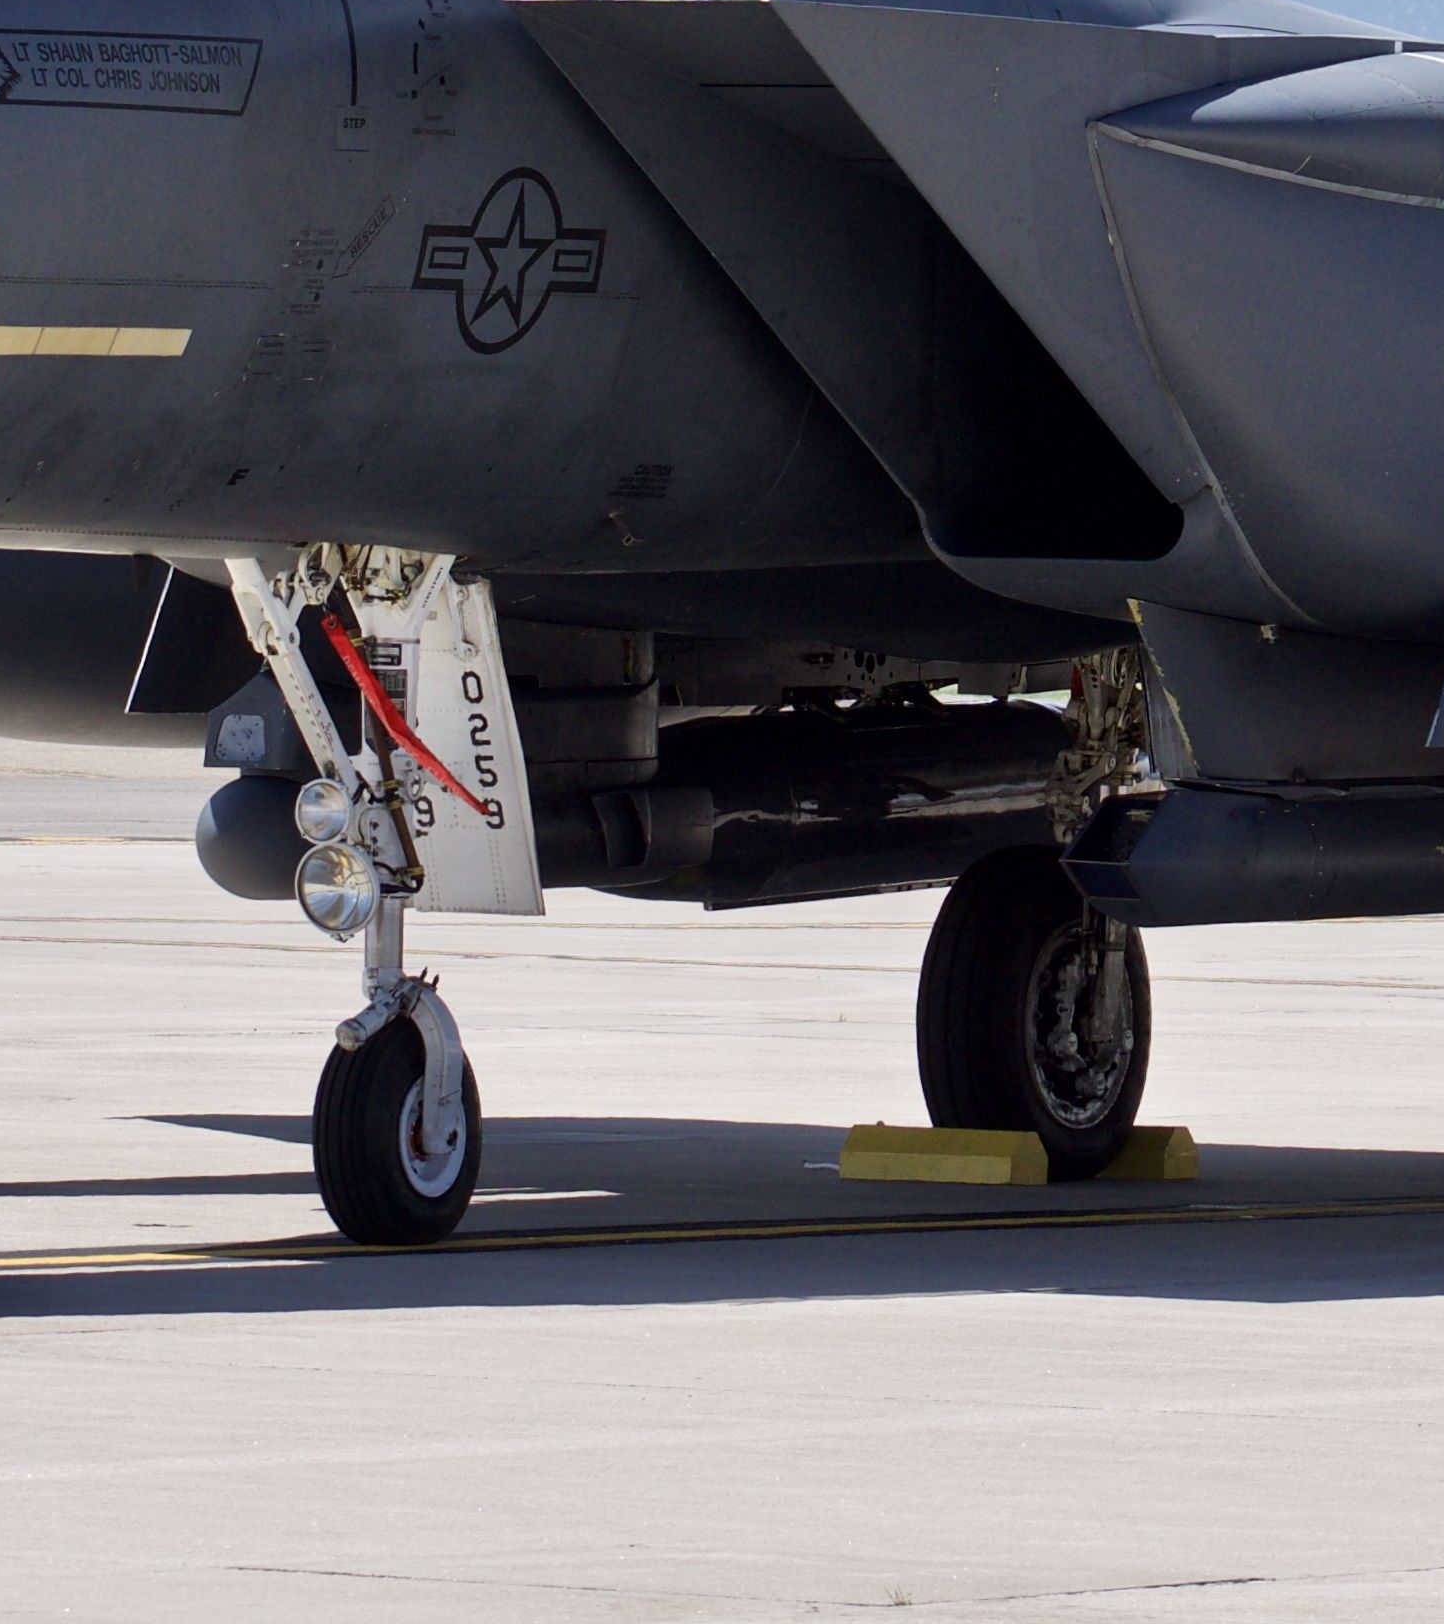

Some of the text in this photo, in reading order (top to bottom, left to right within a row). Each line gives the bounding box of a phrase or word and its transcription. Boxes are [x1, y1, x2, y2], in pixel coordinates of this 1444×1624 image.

[11, 41, 243, 67] LT SHAUN BAGHOTT-SALMON
[31, 68, 221, 93] LT COL CHRIS JOHNSON
[342, 116, 367, 130] STEP
[348, 207, 389, 259] RESCUE
[462, 670, 505, 830] 0259
